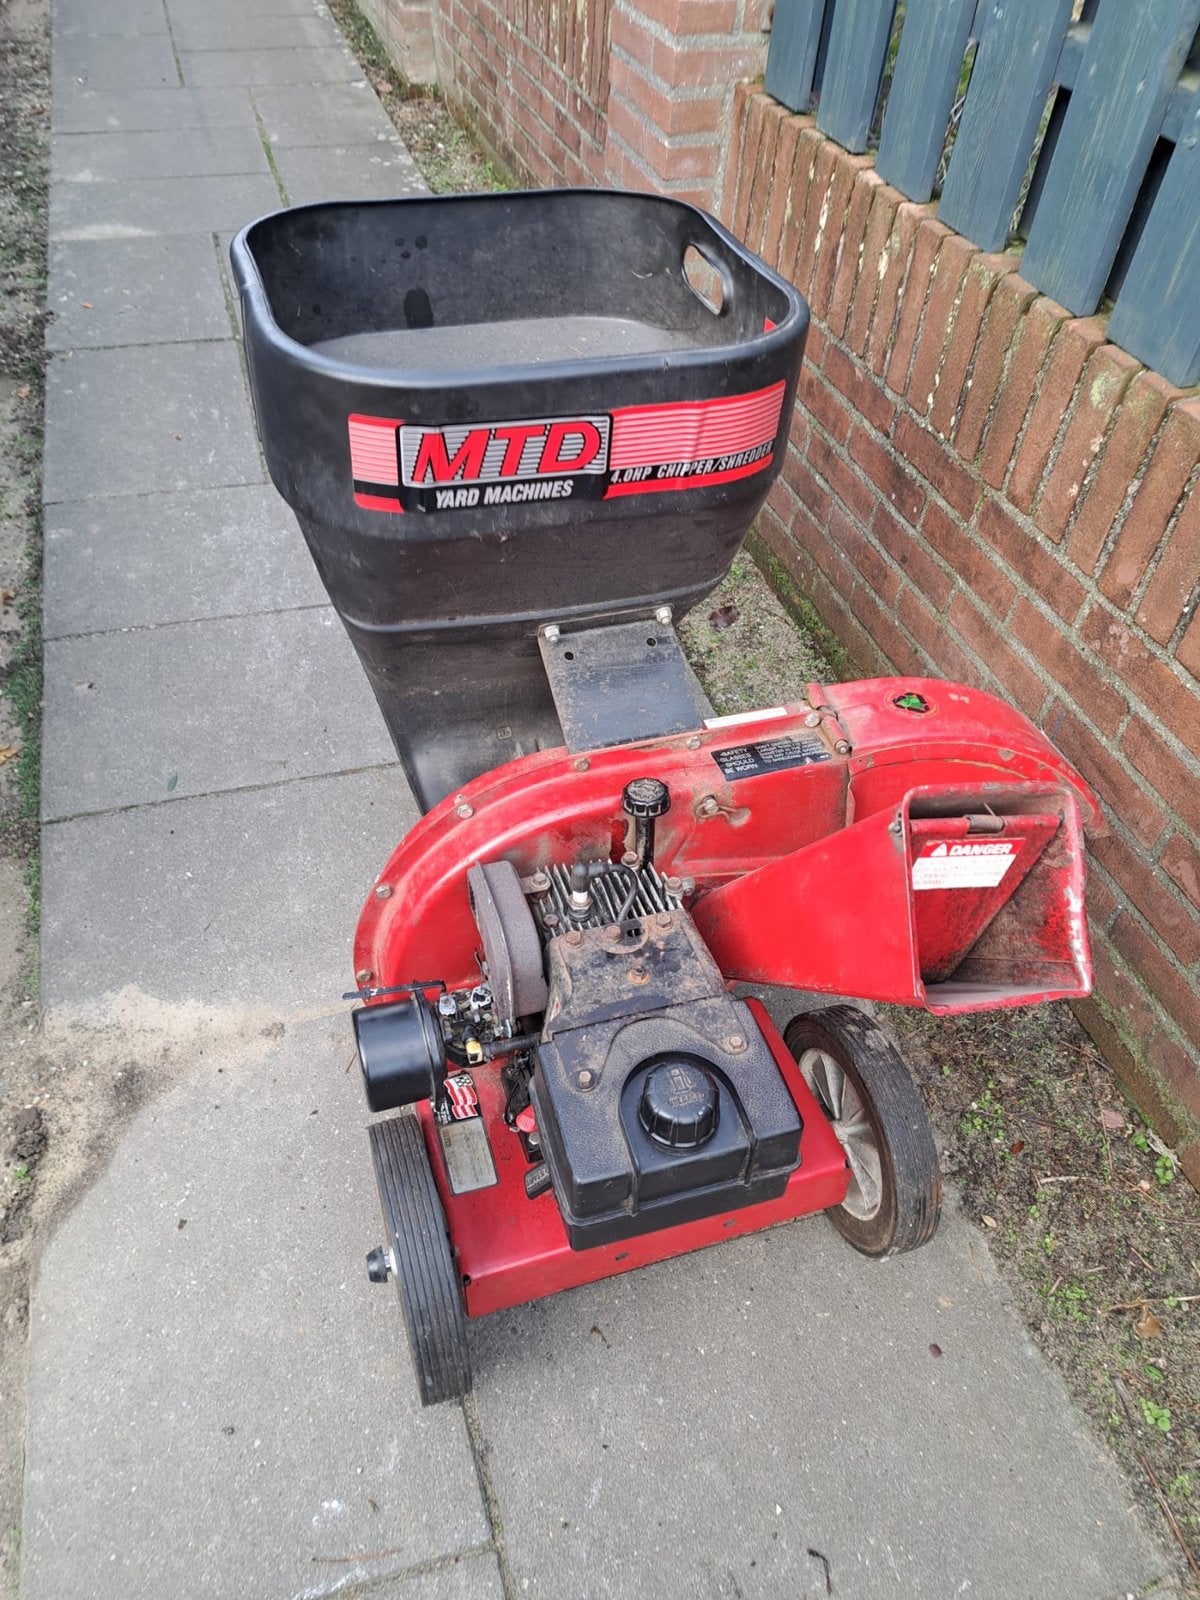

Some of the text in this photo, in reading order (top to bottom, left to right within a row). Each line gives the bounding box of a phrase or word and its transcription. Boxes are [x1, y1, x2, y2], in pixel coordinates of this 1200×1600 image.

[411, 420, 601, 482] MTD
[611, 441, 774, 484] 4.0HP CHIPPER/SHREDDER
[435, 480, 574, 510] YARD MACHINES
[720, 753, 752, 763] GLASSES
[725, 758, 755, 768] SHOULD
[737, 763, 759, 772] WORN
[949, 843, 1013, 856] DANGER
